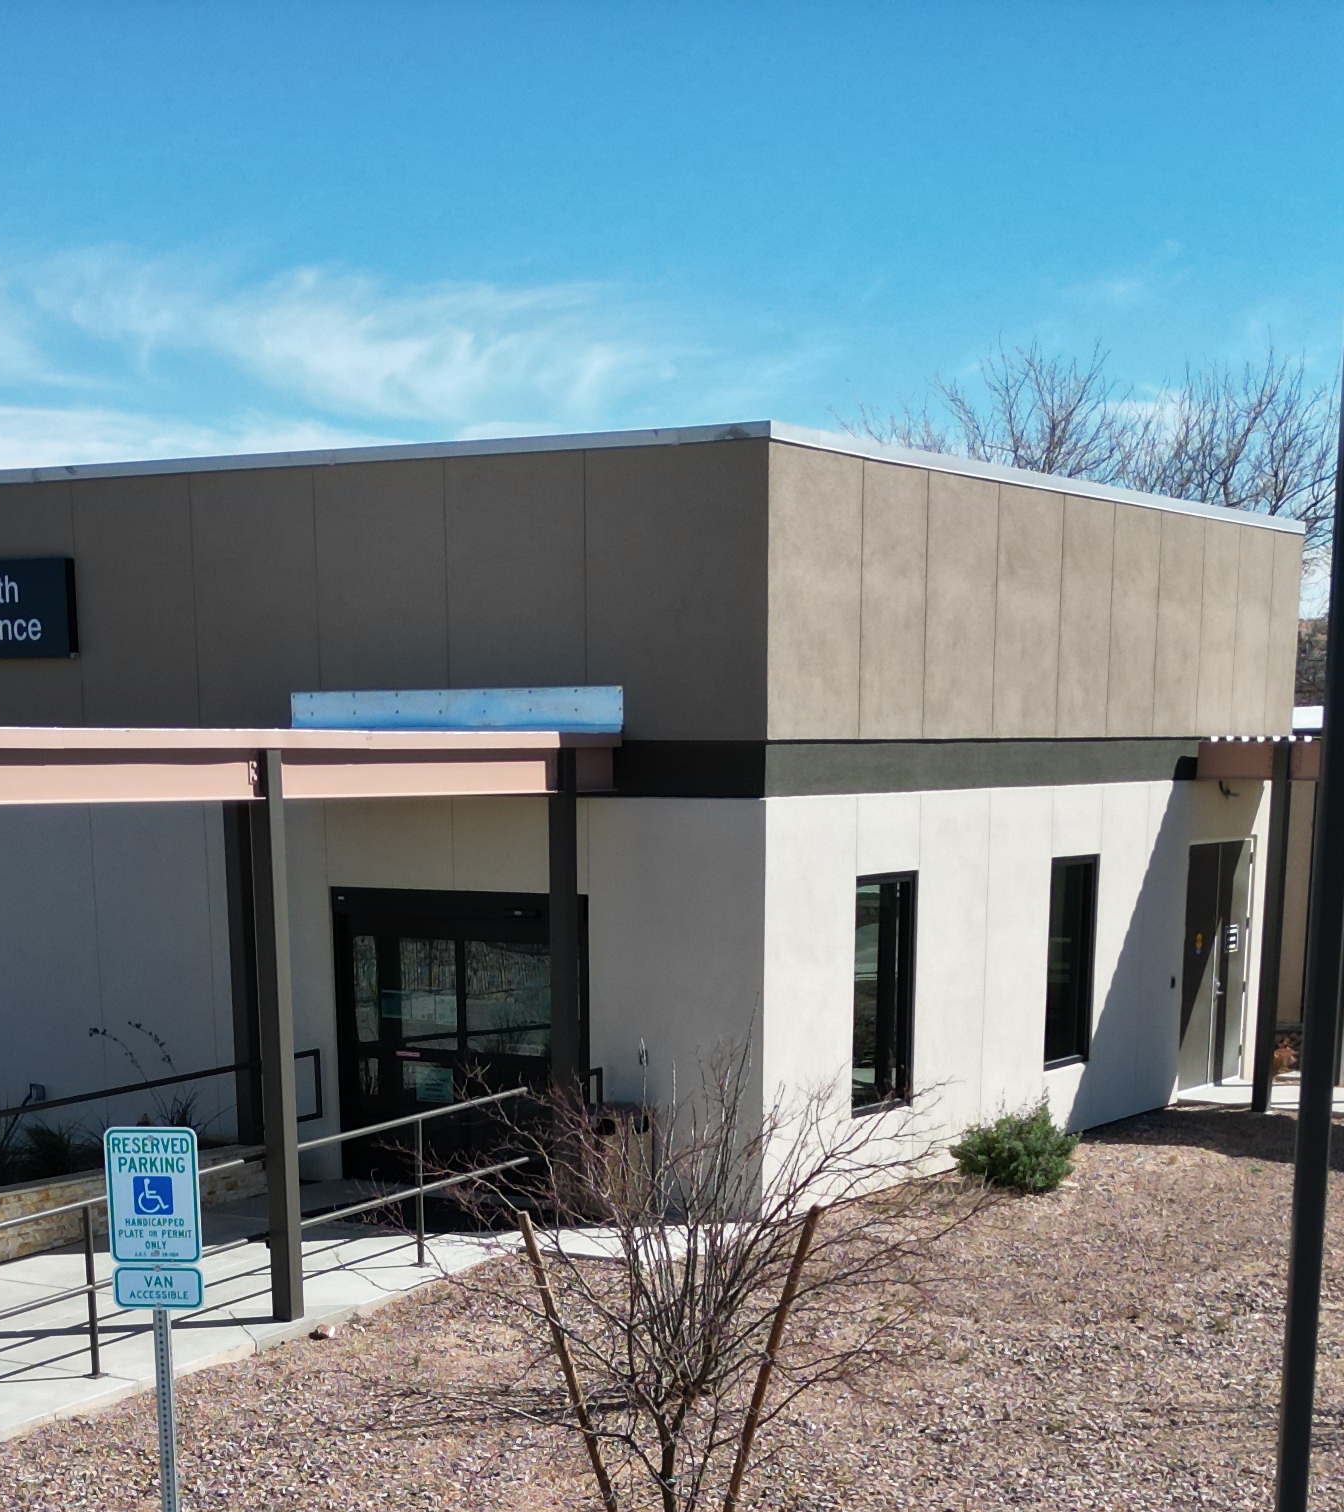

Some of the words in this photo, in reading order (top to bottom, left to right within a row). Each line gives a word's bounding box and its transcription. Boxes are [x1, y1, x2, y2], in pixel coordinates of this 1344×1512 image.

[112, 1137, 190, 1154] RESERVED
[118, 1157, 186, 1174] PARKING
[125, 1217, 184, 1227] HANDICAPPED
[118, 1229, 144, 1239] PLATE
[161, 1229, 192, 1239] PERMIT
[145, 1240, 167, 1250] ONLY
[144, 1275, 174, 1288] VAN
[129, 1290, 189, 1300] ACCESSIBLE
